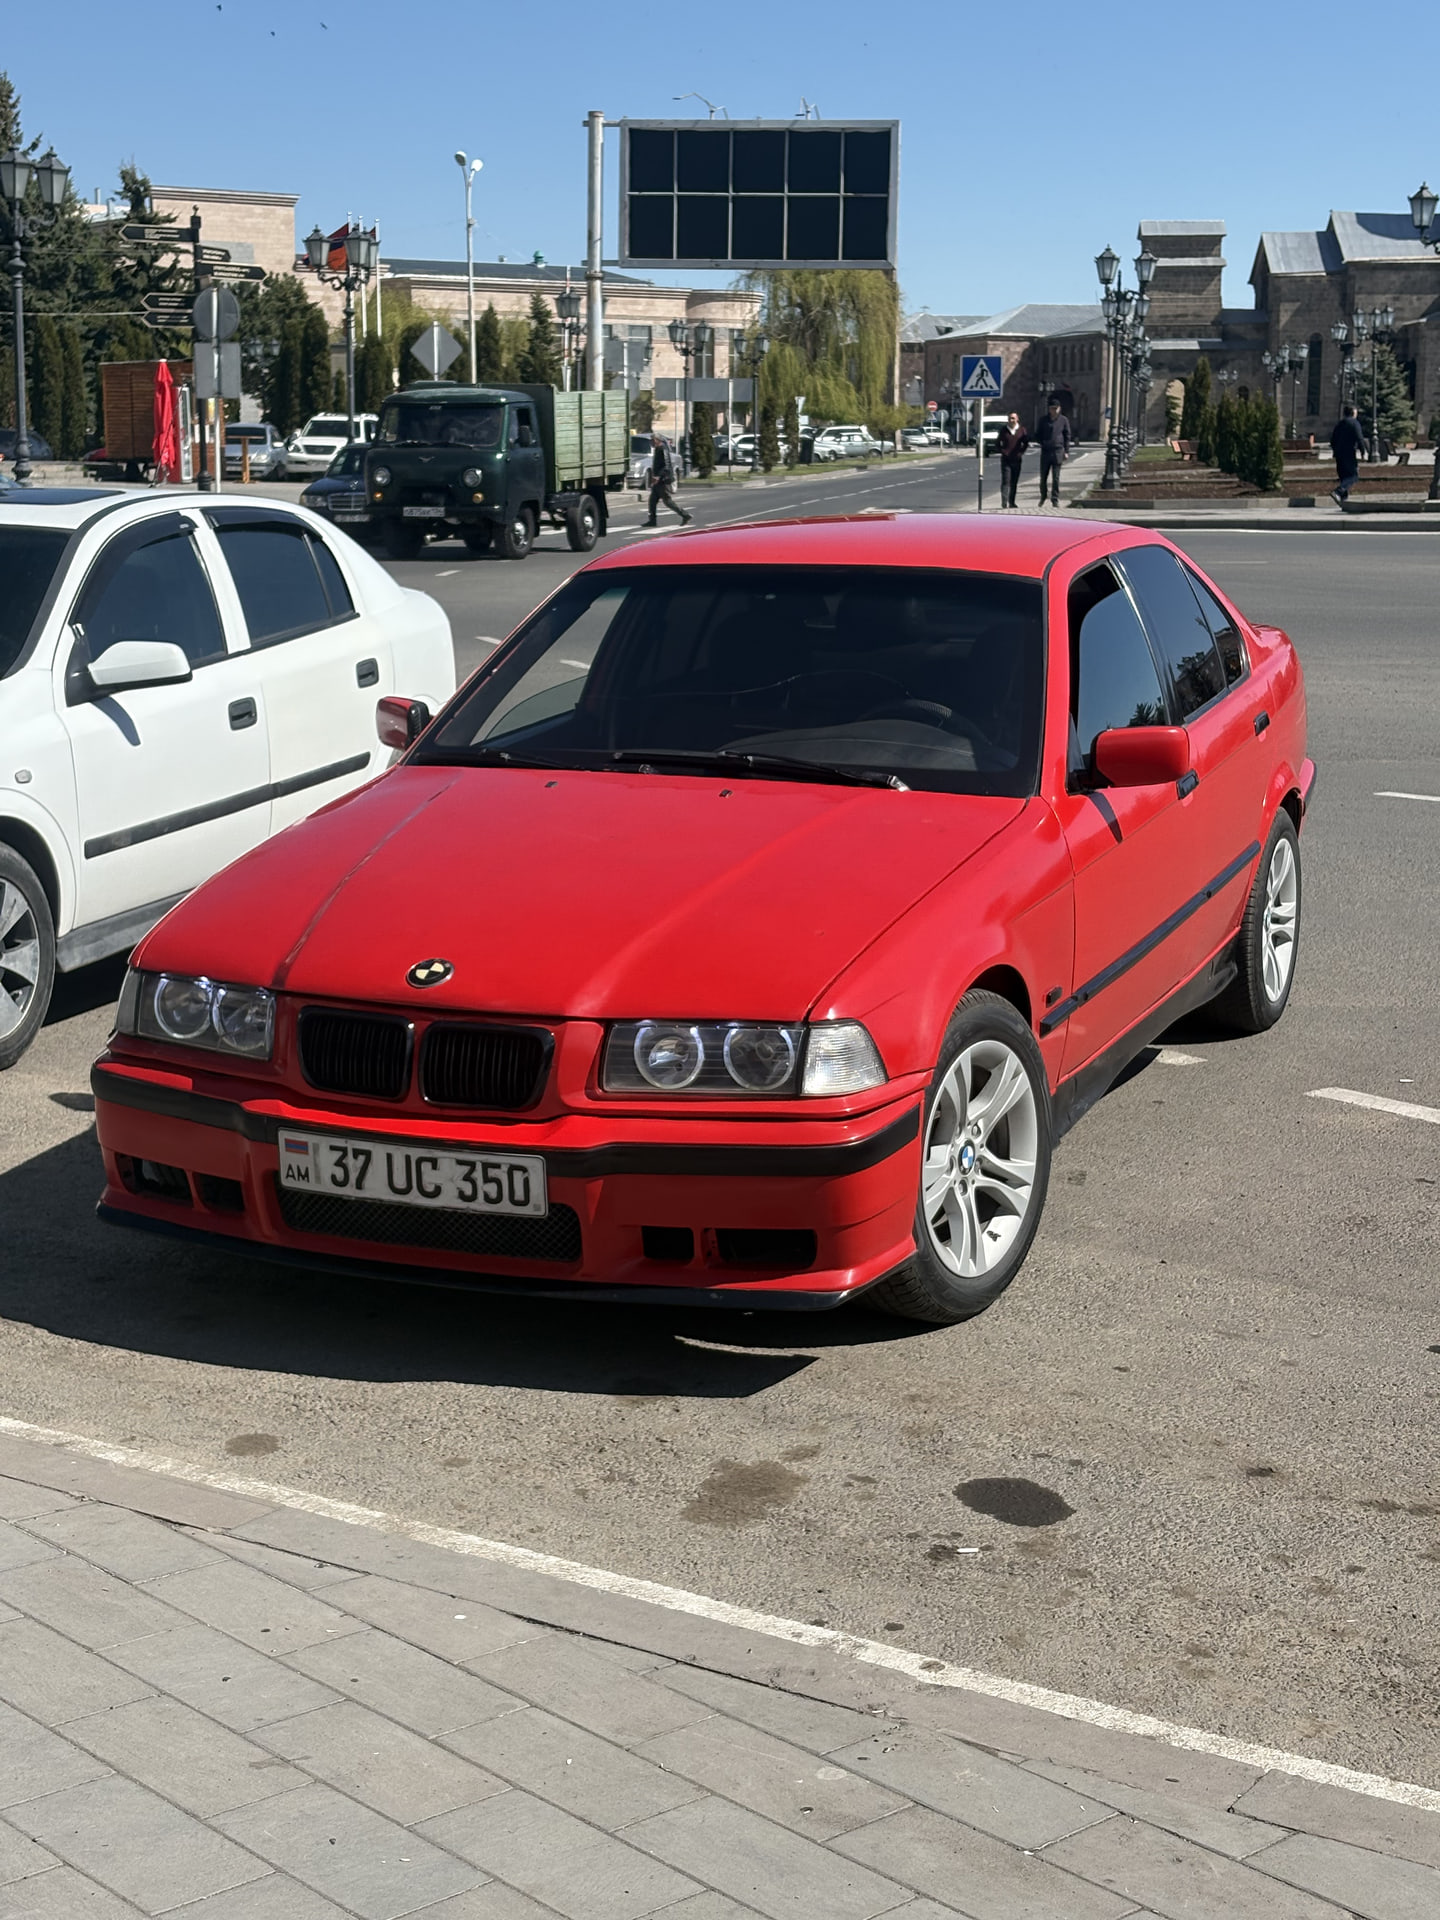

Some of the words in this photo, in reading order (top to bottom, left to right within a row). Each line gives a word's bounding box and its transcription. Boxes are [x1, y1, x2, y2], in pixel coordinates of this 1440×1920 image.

[285, 1163, 310, 1183] AM
[329, 1144, 372, 1190] 37
[386, 1152, 442, 1198] UC
[455, 1159, 530, 1206] 350
